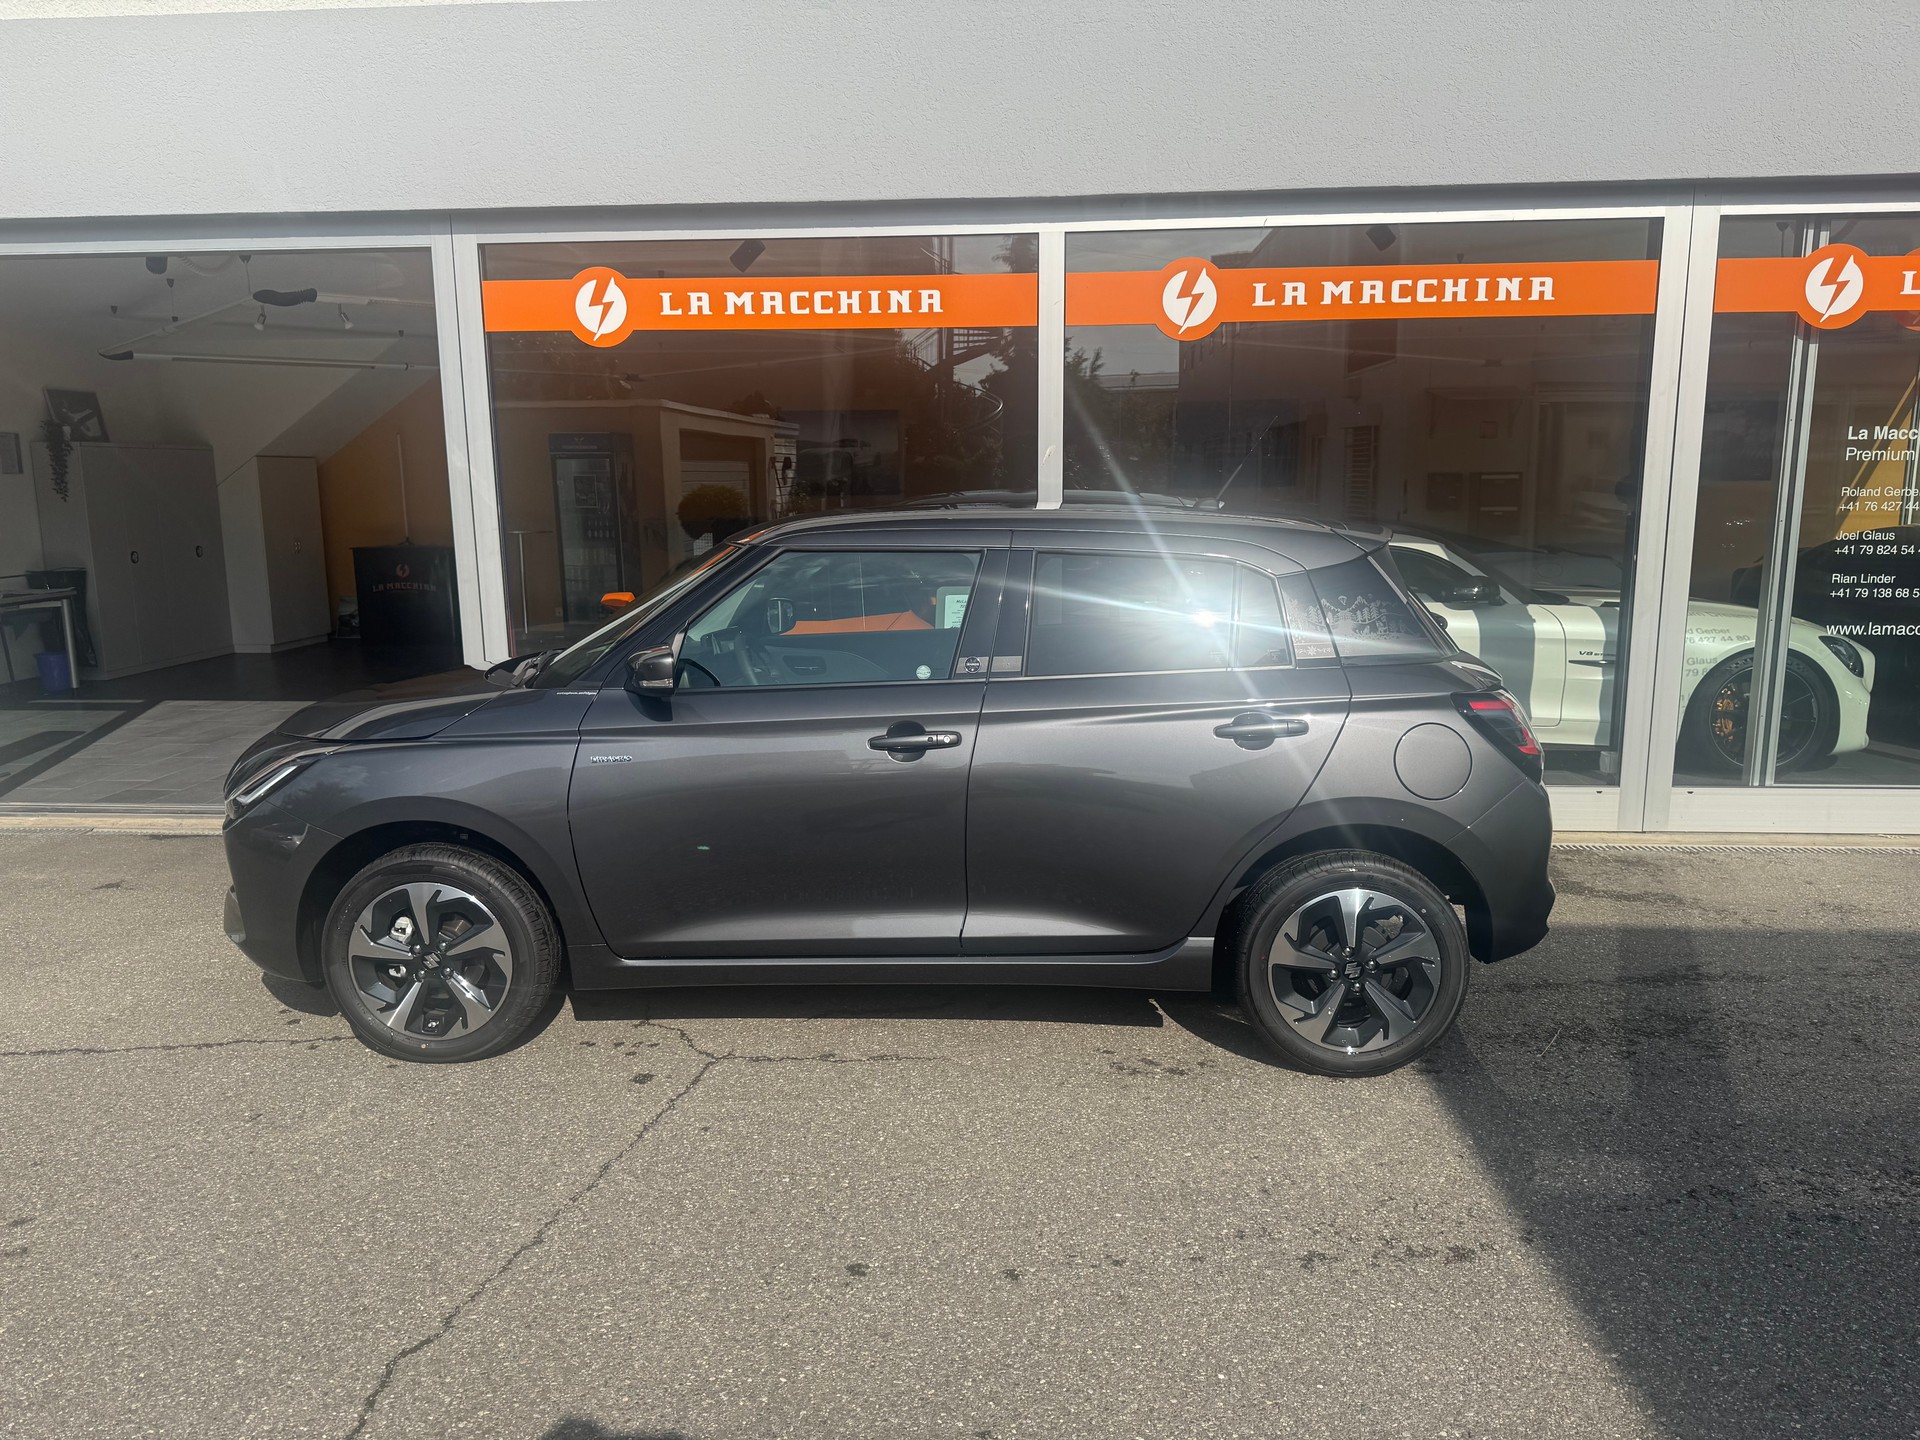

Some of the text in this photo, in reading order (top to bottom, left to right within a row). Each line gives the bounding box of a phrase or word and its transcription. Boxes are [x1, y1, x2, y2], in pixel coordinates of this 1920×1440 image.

[1251, 277, 1556, 306] LA MACCHINA
[659, 289, 943, 315] LA MACCHINA
[1847, 425, 1869, 440] La
[1845, 447, 1916, 461] Premium
[1841, 486, 1920, 497] Roland Gerbe
[1839, 501, 1920, 512] +41 76 427 44
[1835, 530, 1896, 541] Joel Glaus
[1834, 544, 1855, 555] +41
[1859, 544, 1874, 555] 79
[1876, 544, 1898, 555] 824
[1900, 544, 1915, 555] 54
[1831, 573, 1896, 584] Rian Linder
[1829, 588, 1851, 598] +41
[1855, 588, 1869, 598] 79
[1872, 588, 1892, 598] 138
[1895, 588, 1910, 598] 68
[1695, 627, 1731, 635] Gerber
[1686, 657, 1718, 666] Glaus
